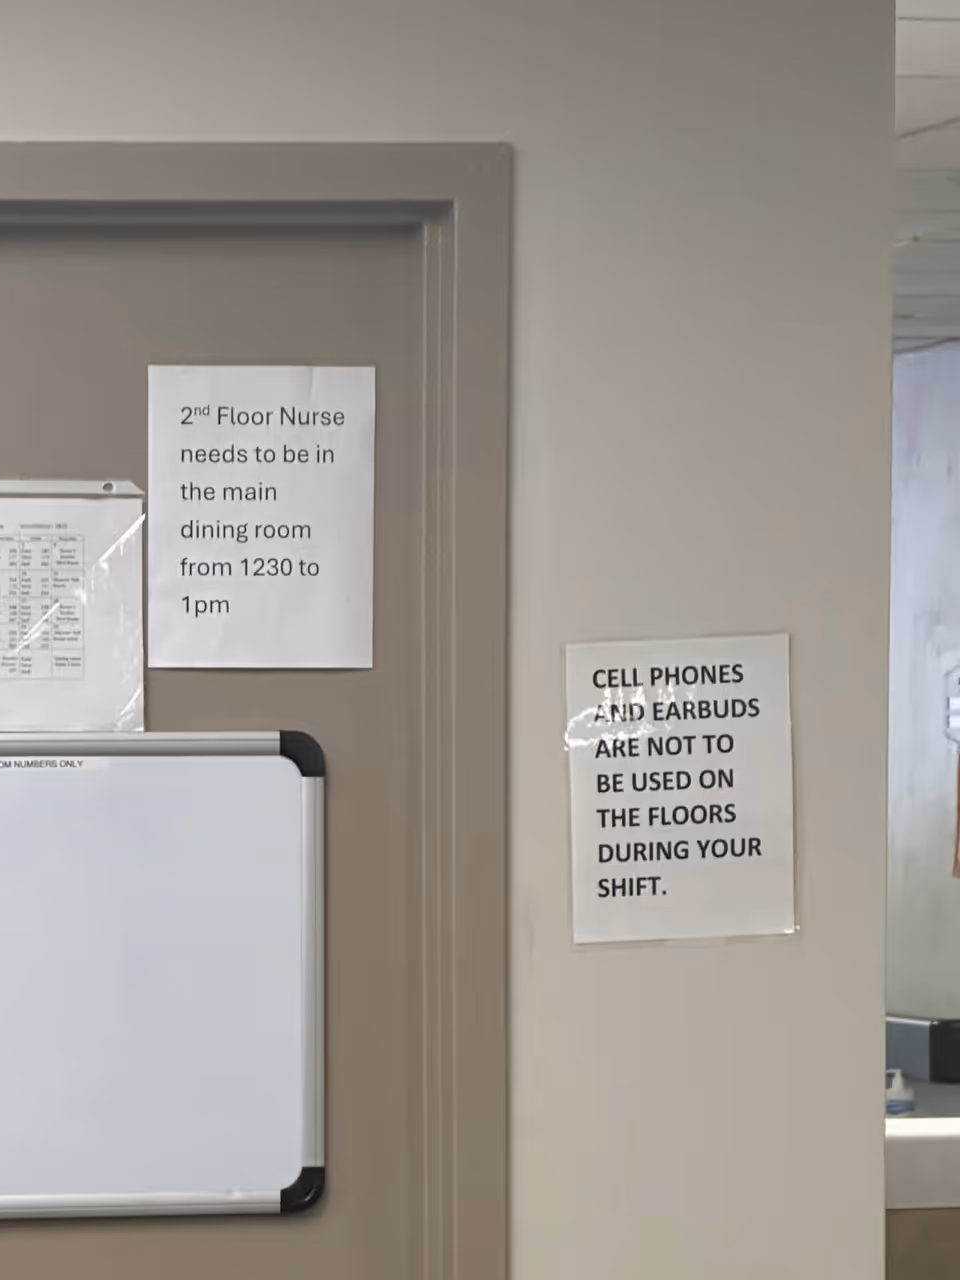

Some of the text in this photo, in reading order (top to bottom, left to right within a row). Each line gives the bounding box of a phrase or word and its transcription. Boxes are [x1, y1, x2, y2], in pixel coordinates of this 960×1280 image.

[180, 405, 345, 425] 2nd Floor Nurse
[181, 445, 334, 463] needs to be in
[180, 482, 277, 500] the main
[181, 520, 311, 543] dining room
[180, 557, 319, 576] from 1230 to
[182, 596, 229, 618] 1pm
[592, 664, 744, 688] CELL PHONES
[595, 698, 760, 723] AND EARBUDS
[595, 734, 734, 759] ARE NOT TO
[13, 760, 58, 768] NUMBERS
[60, 760, 83, 768] ONLY
[597, 769, 734, 793] BE USED ON
[597, 804, 736, 828] THE FLOORS
[599, 838, 762, 863] DURING YOUR
[598, 877, 667, 898] SHIFT.
